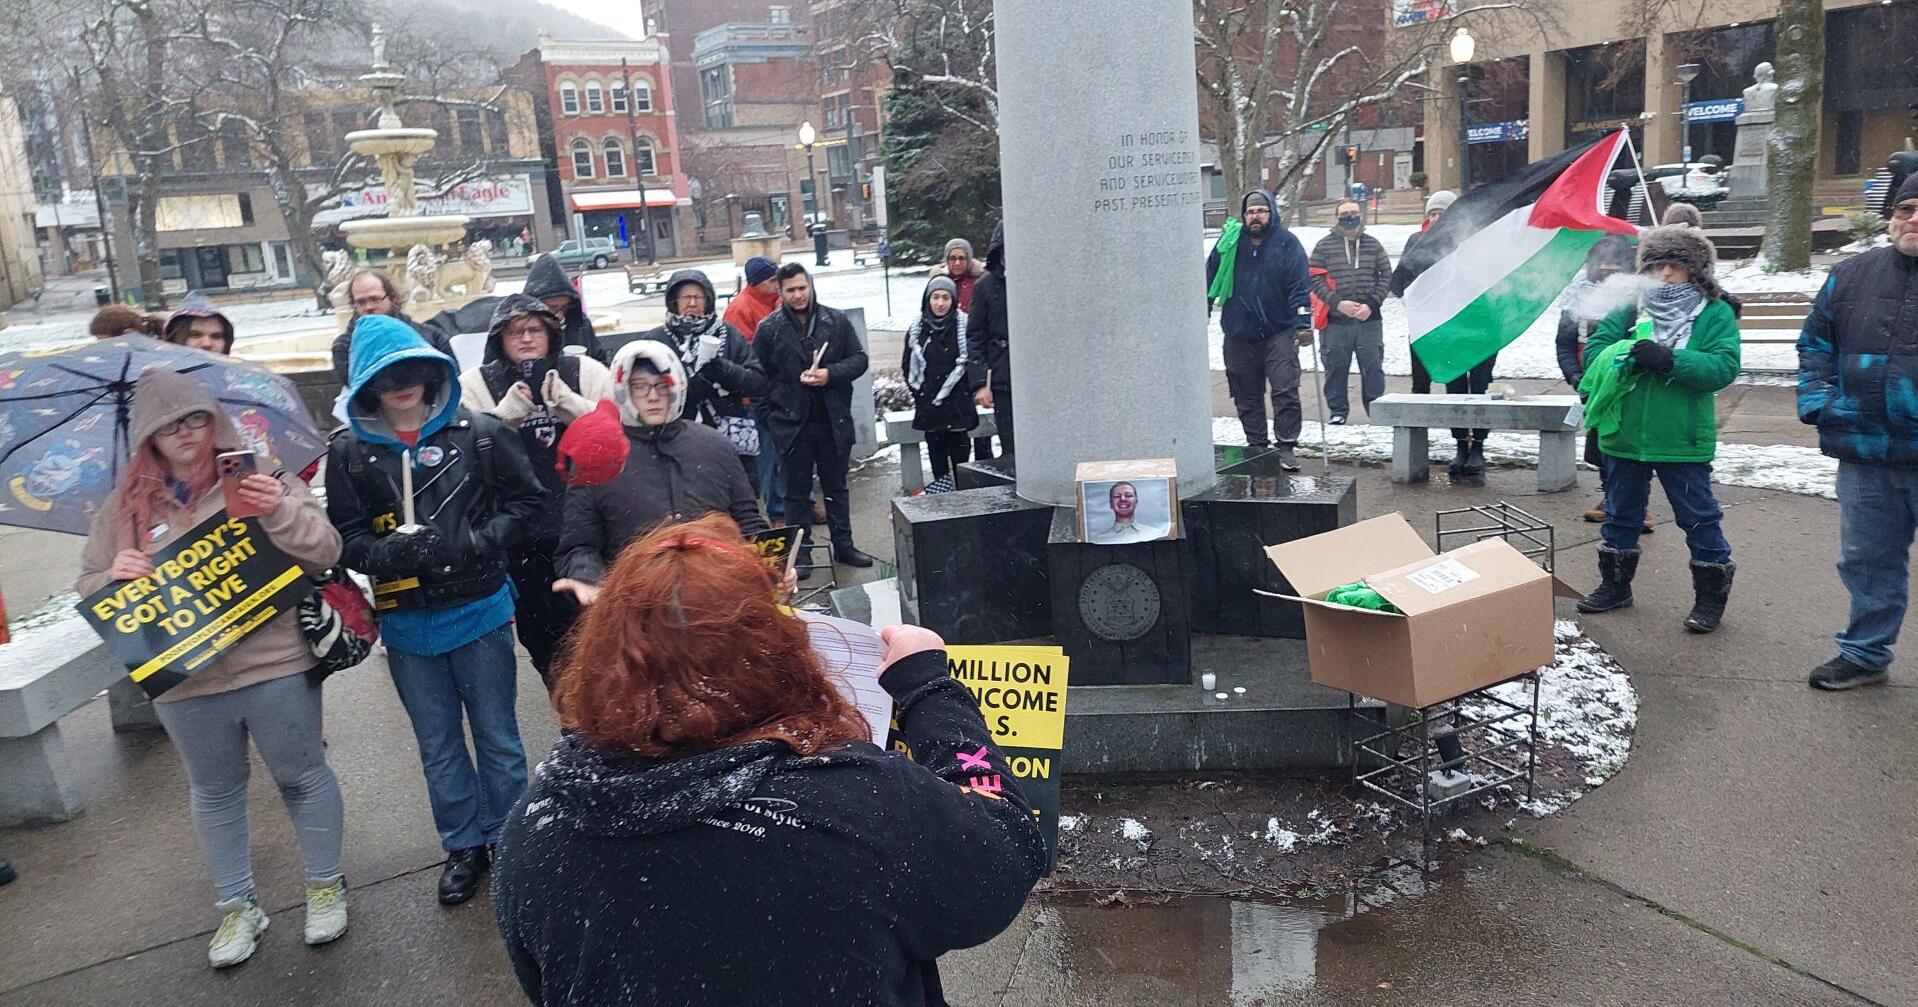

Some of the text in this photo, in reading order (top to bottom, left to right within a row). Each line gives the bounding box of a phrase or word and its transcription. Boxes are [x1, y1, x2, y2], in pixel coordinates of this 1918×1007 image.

[1121, 133, 1134, 147] IN
[1108, 155, 1134, 170] OUR
[459, 180, 510, 204] Eagle
[1099, 177, 1126, 192] AND
[91, 517, 249, 621] EVERYBODY'S
[114, 536, 257, 635] GOT A RIGHT
[157, 573, 249, 636] TO LIVE
[949, 659, 1052, 686] MILLION
[731, 821, 767, 838] 2018.
